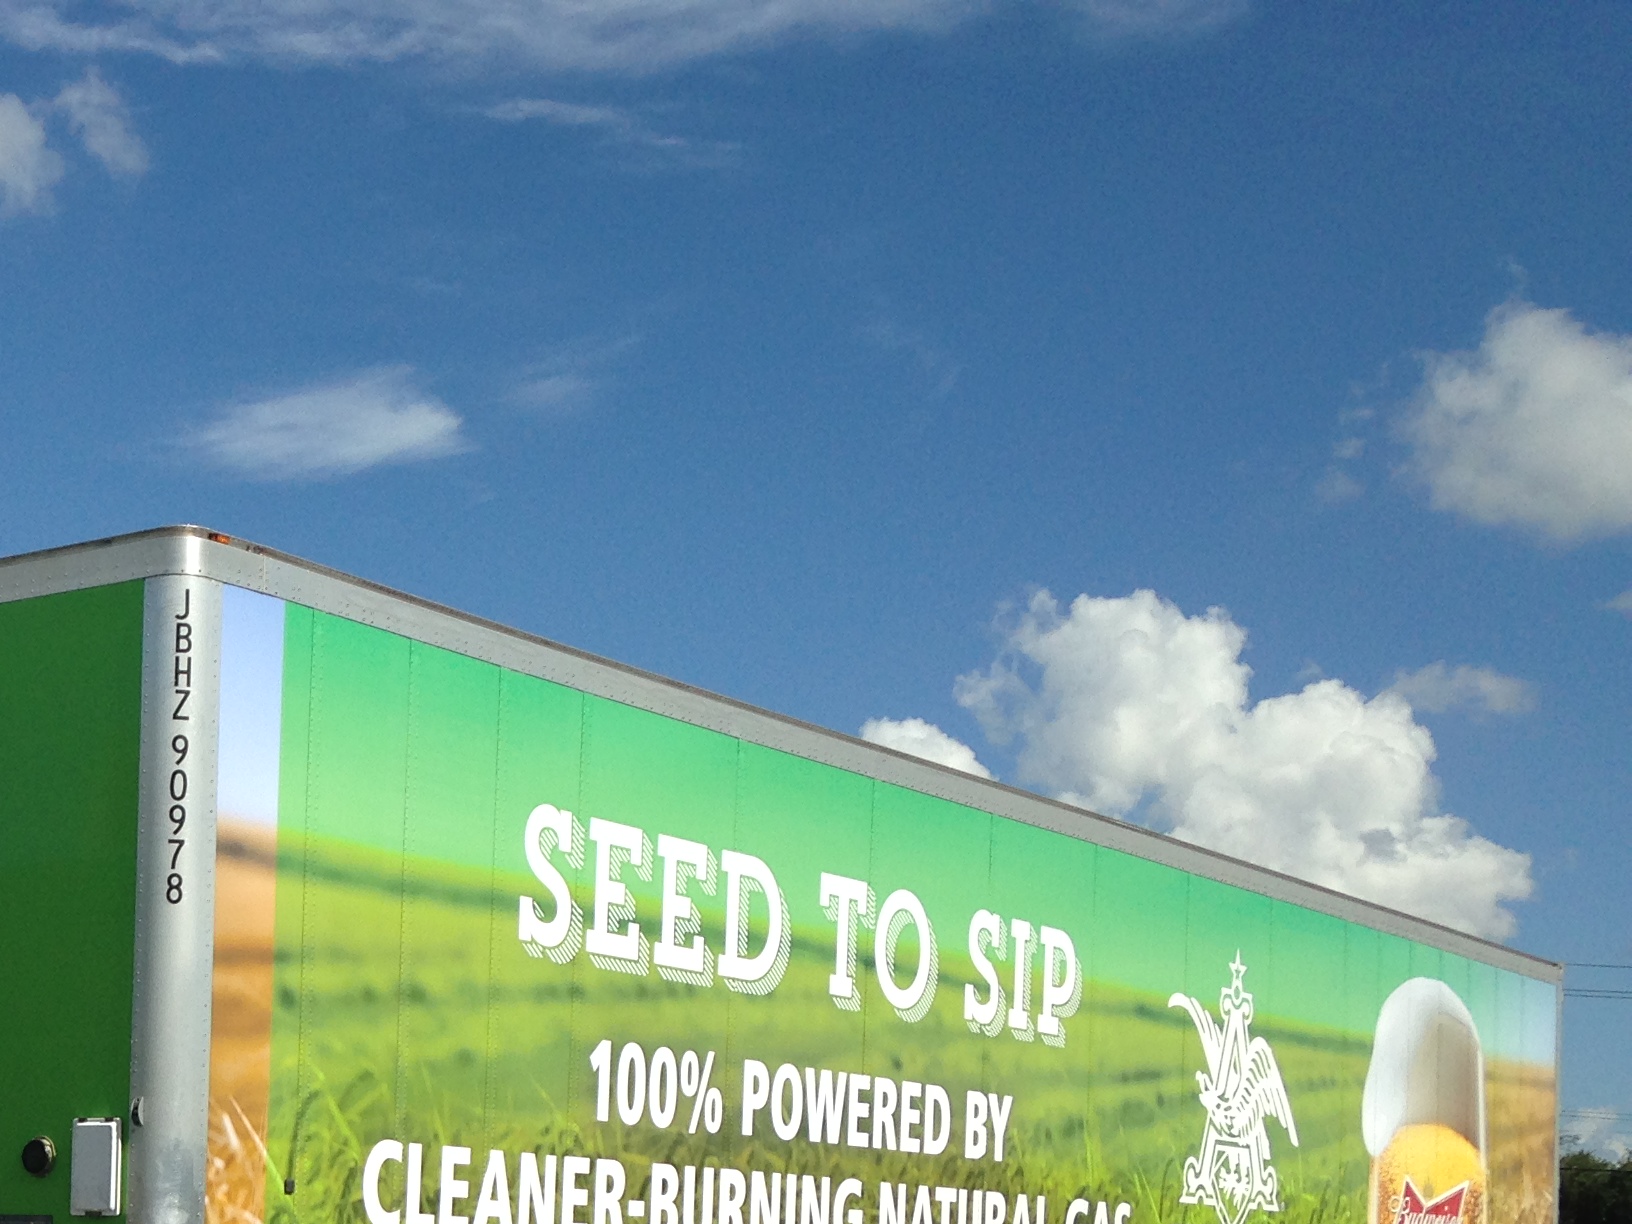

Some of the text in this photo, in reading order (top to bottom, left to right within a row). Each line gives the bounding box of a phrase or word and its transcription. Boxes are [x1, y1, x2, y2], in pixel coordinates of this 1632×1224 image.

[166, 588, 192, 904] JBHZ 90978
[518, 804, 1082, 1048] SEED TO SIP
[589, 1039, 1013, 1162] 100% POWERED BY
